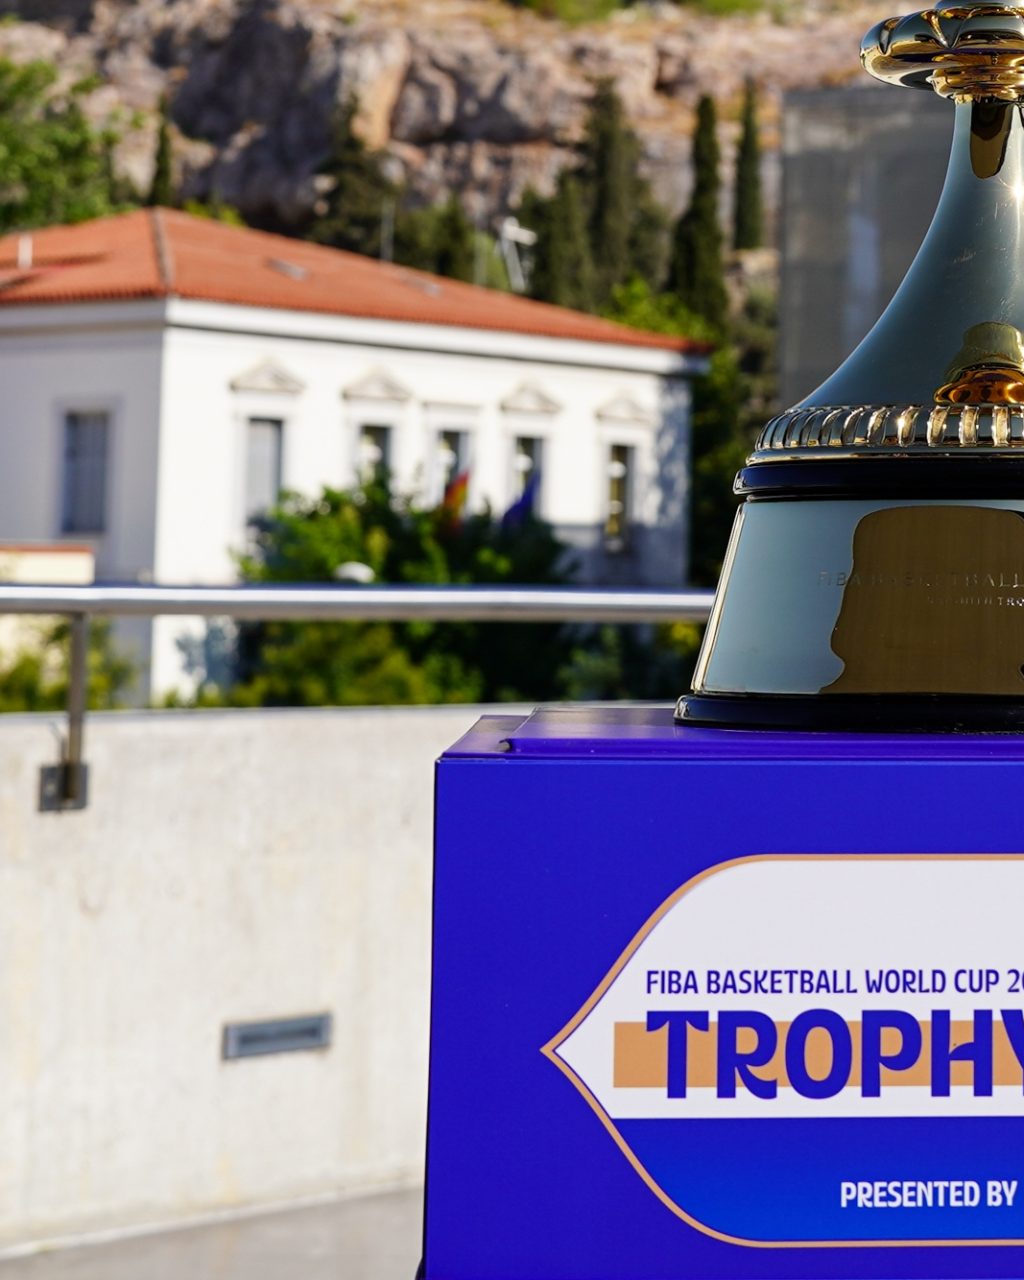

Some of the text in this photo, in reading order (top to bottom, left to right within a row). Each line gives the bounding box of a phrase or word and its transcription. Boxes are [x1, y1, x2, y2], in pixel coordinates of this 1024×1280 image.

[646, 970, 699, 995] FIBA
[706, 969, 858, 994] BASKETBALL
[865, 969, 947, 994] WORLD
[954, 968, 1000, 993] CUP
[840, 1180, 981, 1208] PRESENTED
[986, 1180, 1018, 1207] BY
